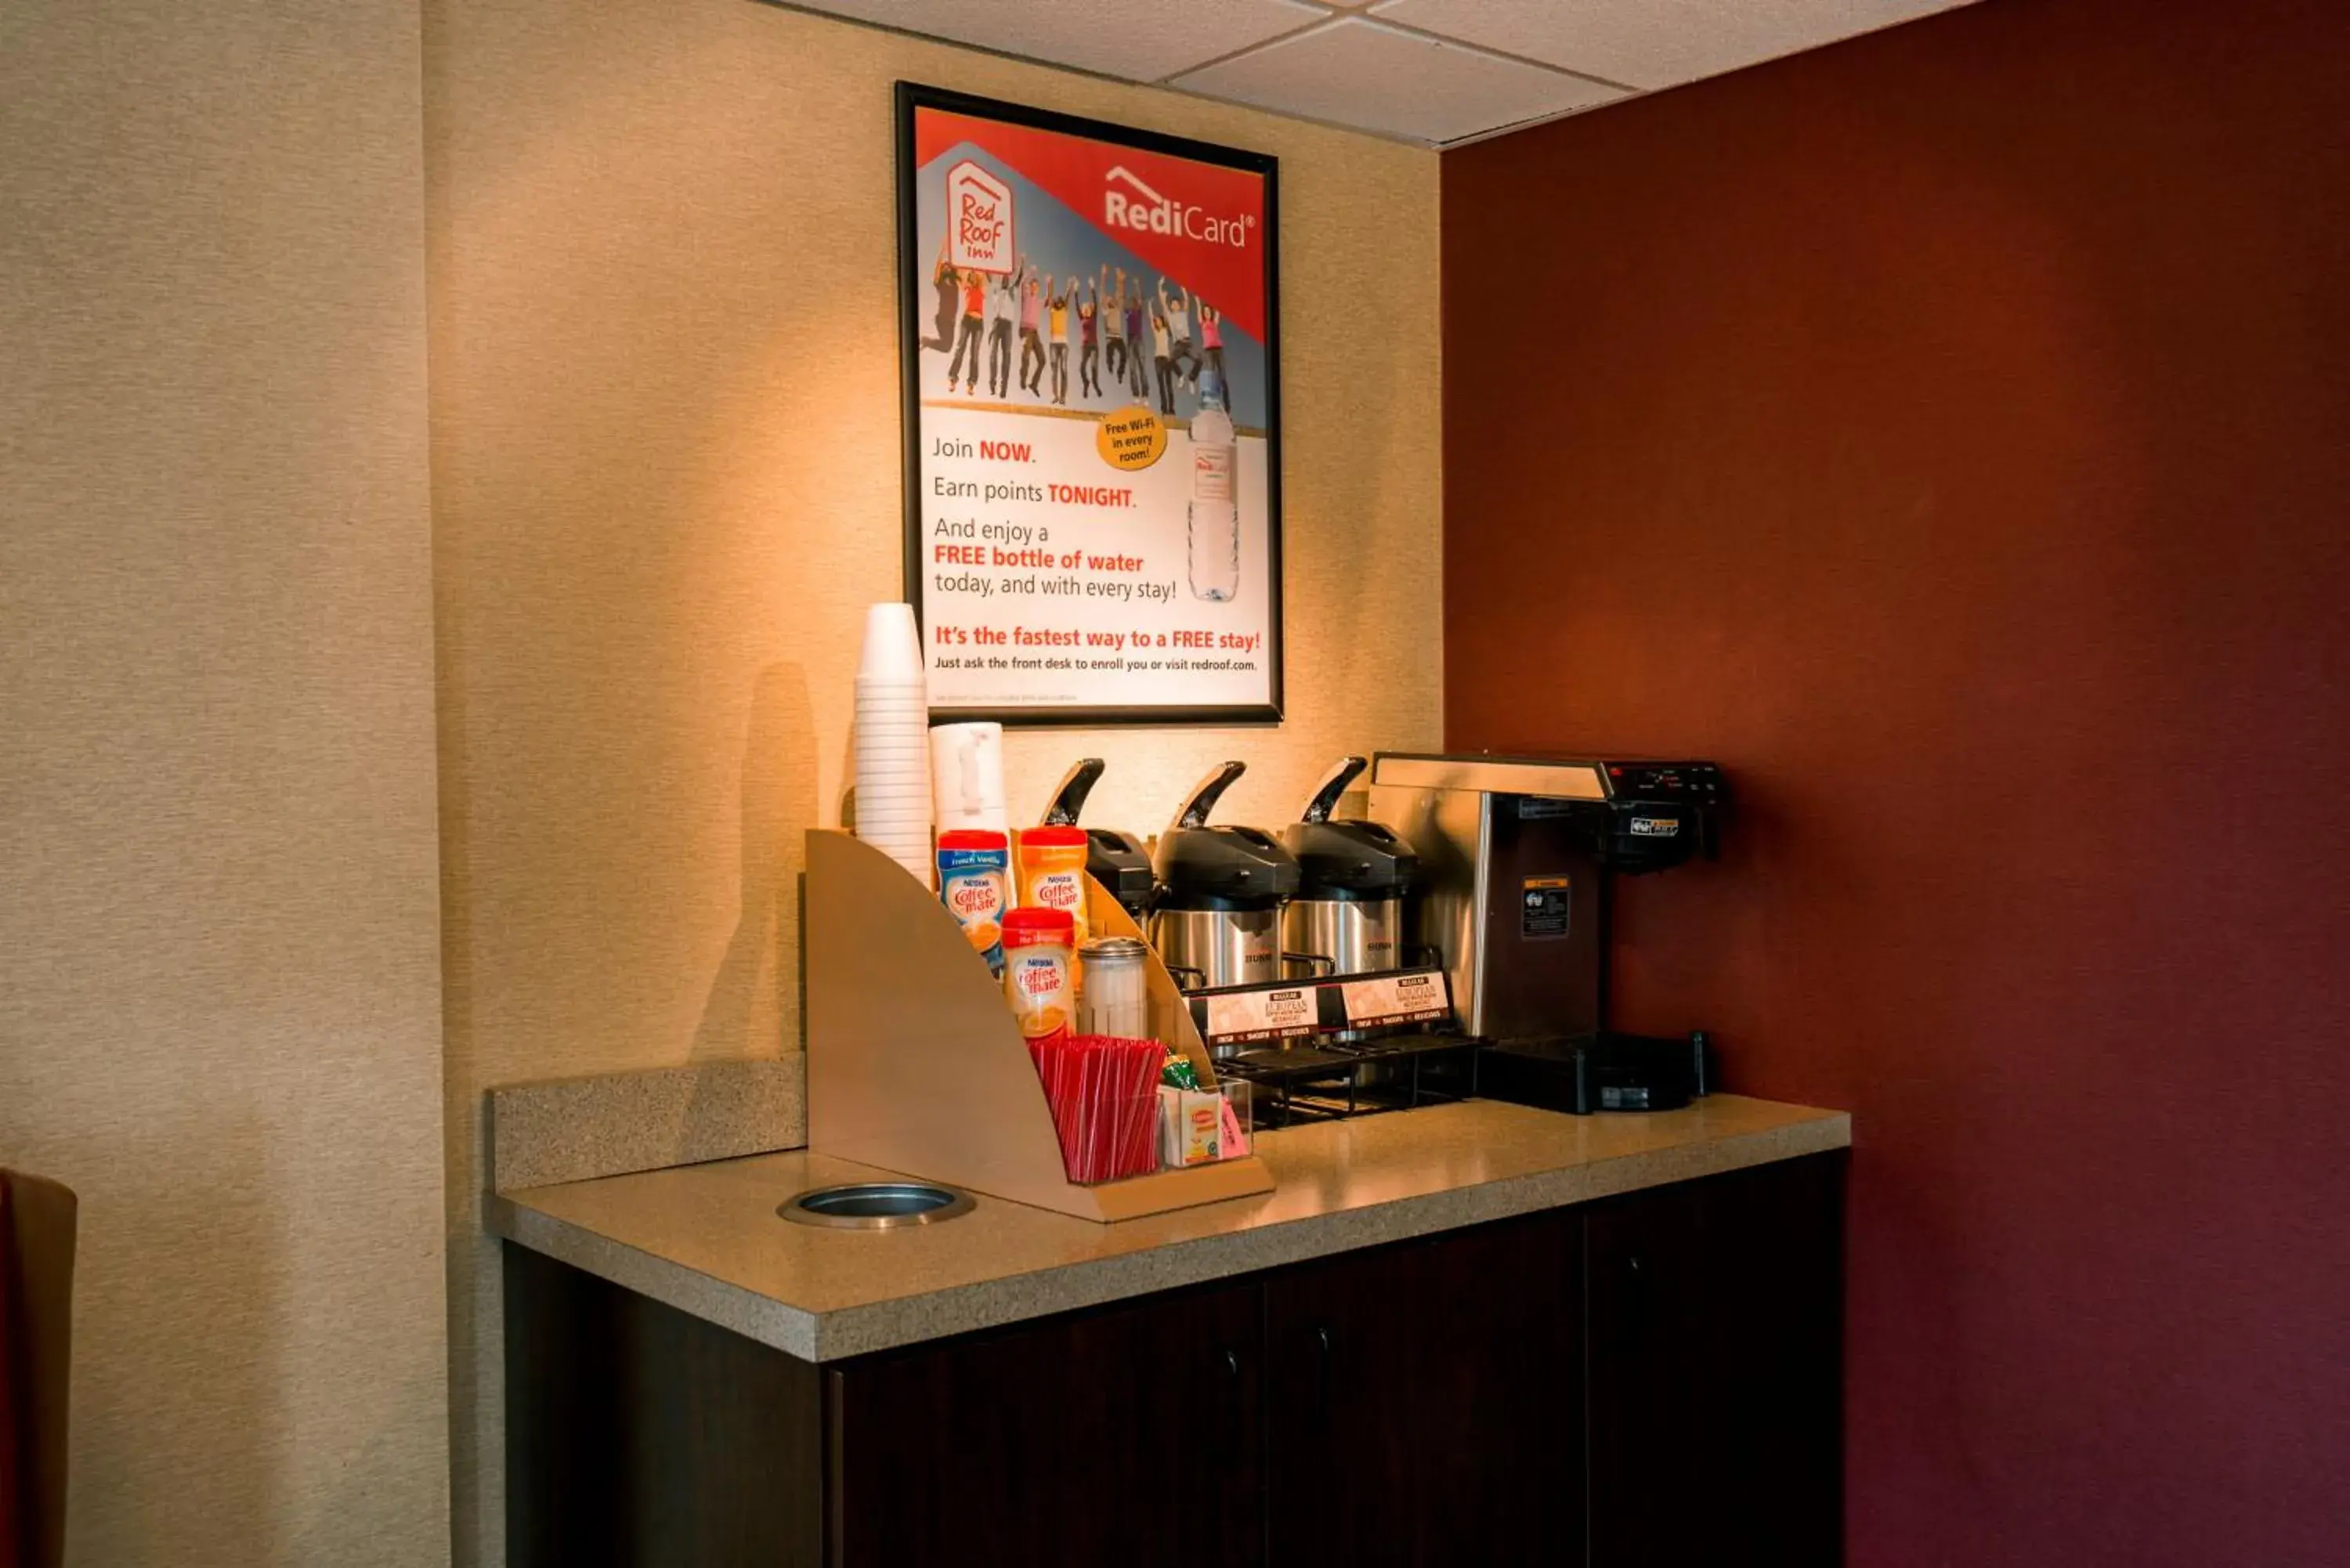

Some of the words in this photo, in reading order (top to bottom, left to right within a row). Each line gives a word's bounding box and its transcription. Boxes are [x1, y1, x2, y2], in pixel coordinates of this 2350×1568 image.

[962, 193, 996, 222] Red
[960, 220, 1004, 247] Roof
[1105, 422, 1127, 435] Free
[1130, 418, 1155, 432] Wi-Fi
[933, 438, 973, 458] Join
[980, 440, 1036, 464] NOW.
[1112, 437, 1123, 448] in
[1125, 435, 1152, 449] every
[1119, 449, 1151, 462] room!
[935, 478, 978, 497] Earn
[985, 482, 1043, 503] points
[1048, 484, 1137, 508] TONIGHT.
[935, 518, 974, 537] And
[982, 520, 1032, 544] enjoy
[1039, 526, 1048, 541] a
[935, 545, 985, 565] FREE
[993, 547, 1054, 568] bottle
[1061, 551, 1081, 569] of
[1088, 555, 1143, 572] water
[935, 573, 994, 596] today,
[1001, 575, 1035, 594] and
[1042, 576, 1080, 595] with
[1086, 582, 1132, 602] every
[1137, 583, 1176, 602] stay!
[936, 627, 967, 644] It’s
[974, 627, 1007, 645] the
[1014, 627, 1080, 646] fastest
[1086, 631, 1125, 650] way
[1131, 630, 1150, 648] to
[1157, 634, 1167, 648] a
[1173, 631, 1213, 648] FREE
[1220, 631, 1260, 652] stay!
[935, 658, 960, 669] Just
[964, 659, 984, 669] ask
[989, 658, 1007, 669] the
[1012, 658, 1042, 670] front
[1046, 659, 1072, 670] desk
[1076, 659, 1087, 670] to
[1091, 659, 1123, 670] enroll
[1126, 660, 1147, 673] you
[1151, 660, 1162, 670] or
[1166, 659, 1188, 670] visit
[1191, 659, 1257, 671] redroof.com.
[956, 888, 992, 905] Coffee
[1040, 883, 1075, 901] Coffee
[966, 898, 996, 913] mate
[1029, 978, 1059, 993] mate
